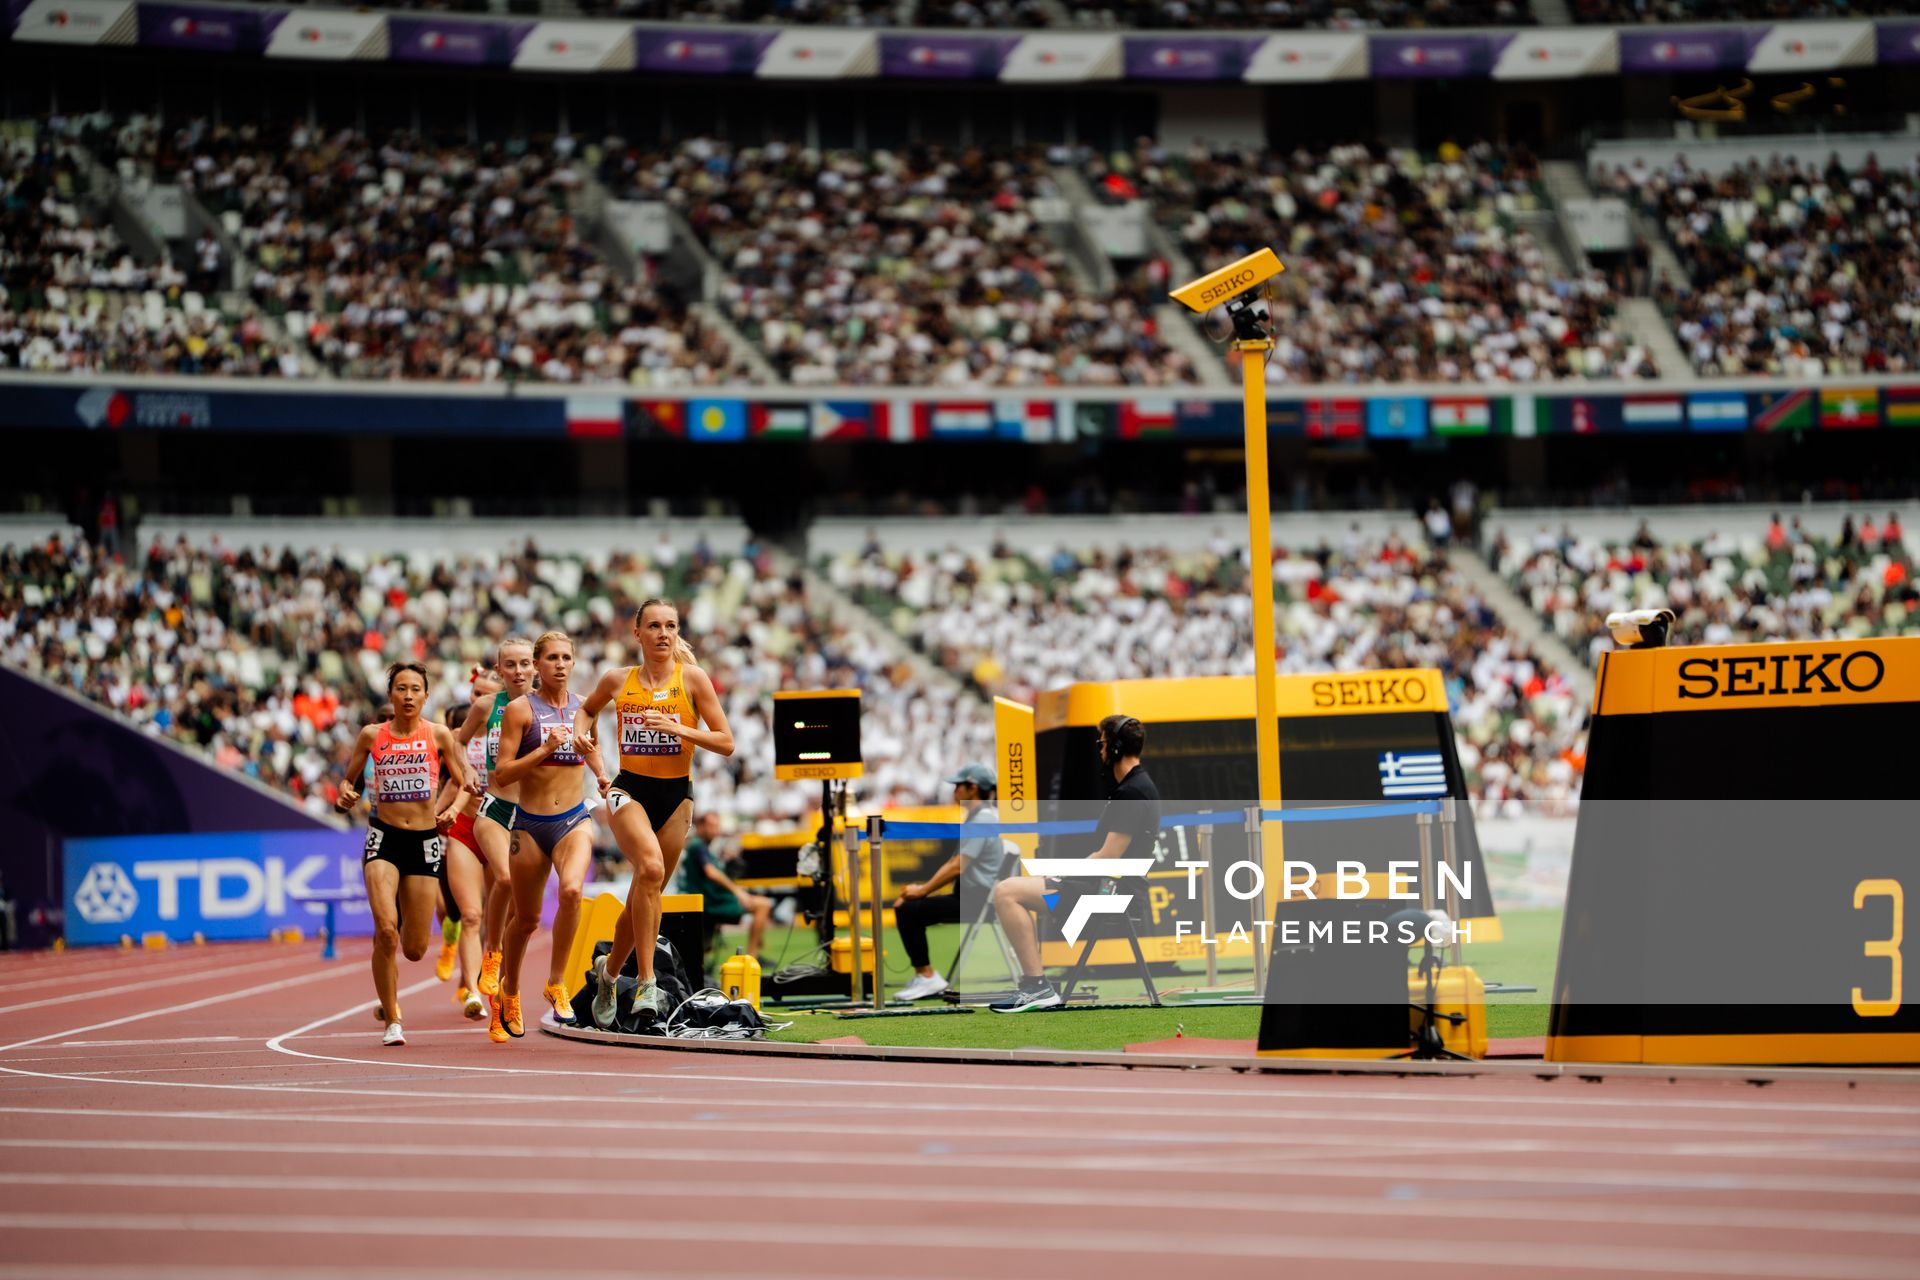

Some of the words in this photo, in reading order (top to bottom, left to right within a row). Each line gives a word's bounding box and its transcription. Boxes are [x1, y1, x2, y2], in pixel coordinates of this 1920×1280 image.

[1200, 269, 1255, 304] SEIKO
[1678, 650, 1885, 699] SEIKO
[1311, 677, 1426, 708] SEIKO
[625, 730, 678, 743] MEYER
[376, 753, 427, 766] JAPAN
[377, 765, 428, 777] HONDA
[793, 767, 836, 778] SEIKO
[1008, 742, 1025, 812] SEIKO
[383, 778, 425, 792] SAITO
[611, 793, 624, 807] 7
[366, 831, 378, 848] 8
[431, 842, 439, 858] 8
[133, 855, 329, 920] TDK
[1851, 879, 1904, 1017] 3
